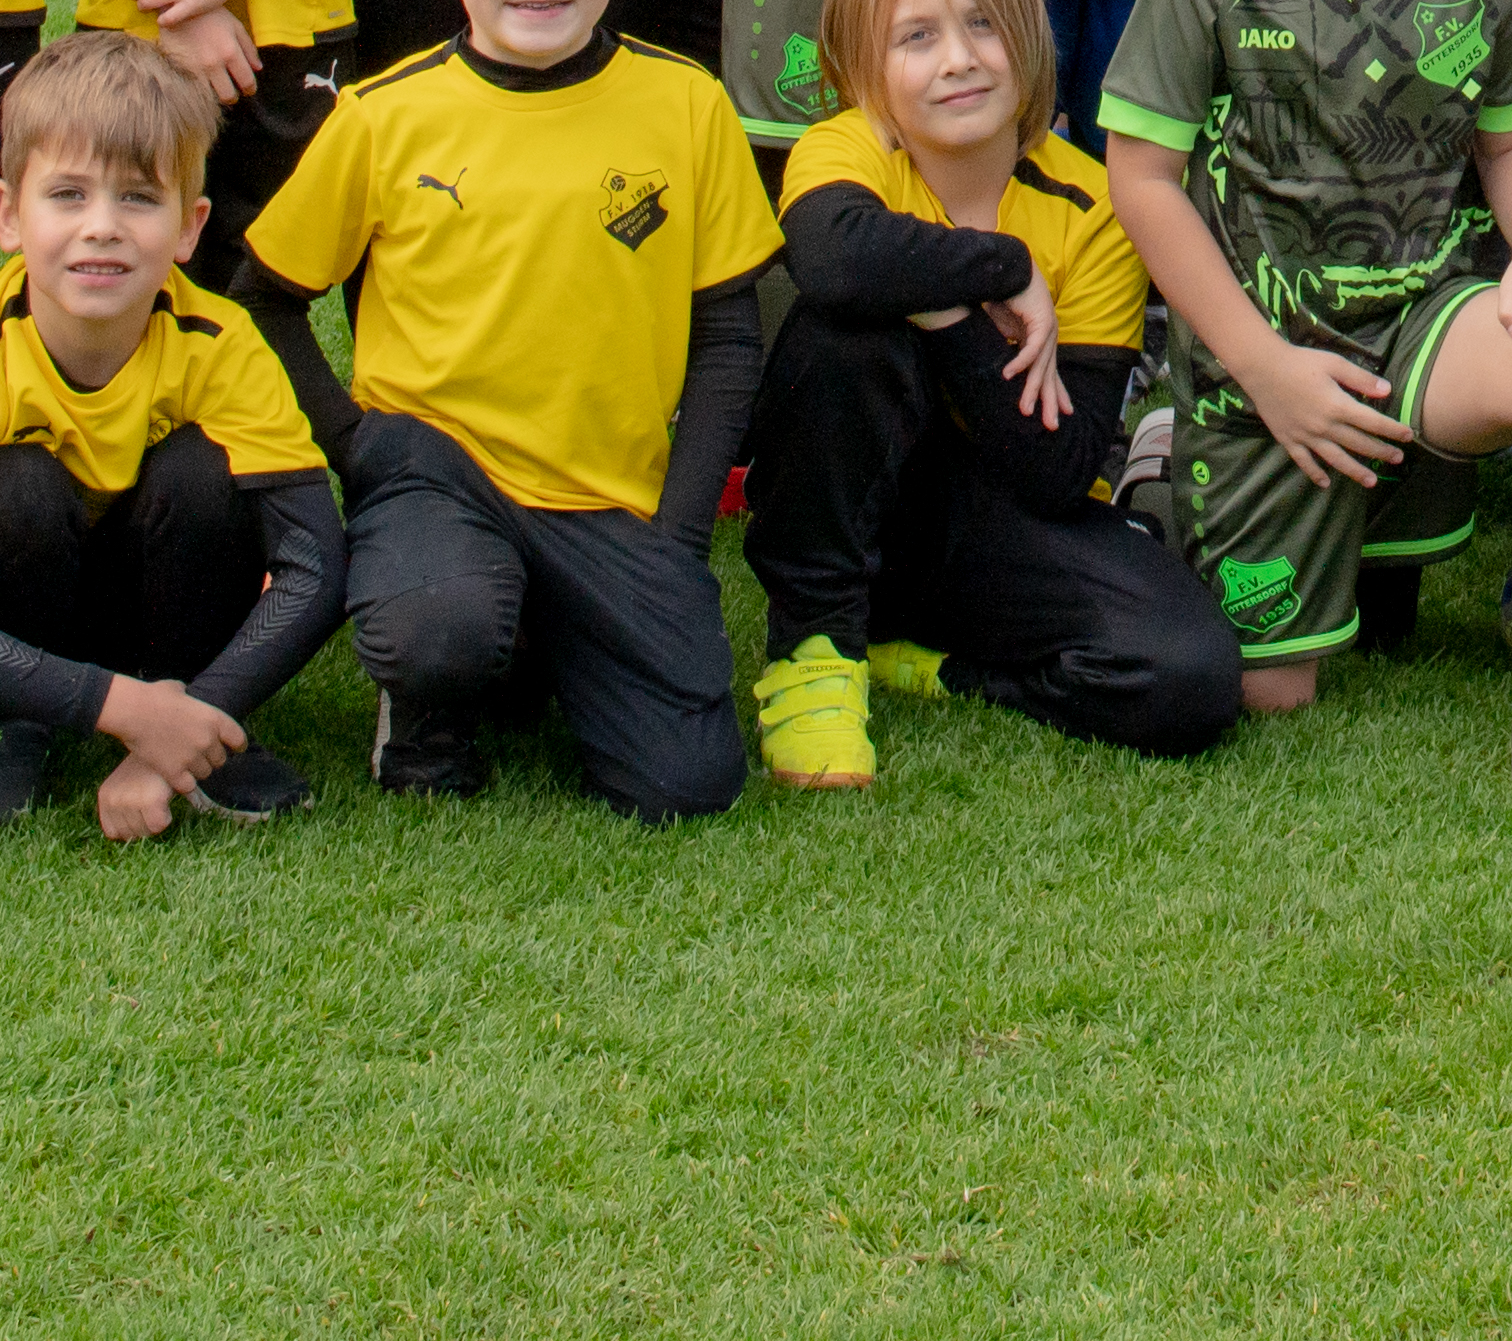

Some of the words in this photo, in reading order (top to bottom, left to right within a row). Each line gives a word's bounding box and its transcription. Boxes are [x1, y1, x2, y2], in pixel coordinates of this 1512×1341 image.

[1237, 28, 1296, 50] JAKO
[1434, 16, 1464, 42] F.V.
[1451, 47, 1483, 78] 1935
[630, 183, 657, 205] 1918
[625, 213, 652, 238] STURM
[1228, 579, 1289, 614] OTTERSDORF
[1239, 577, 1263, 594] F.V.
[1258, 598, 1294, 626] 1935
